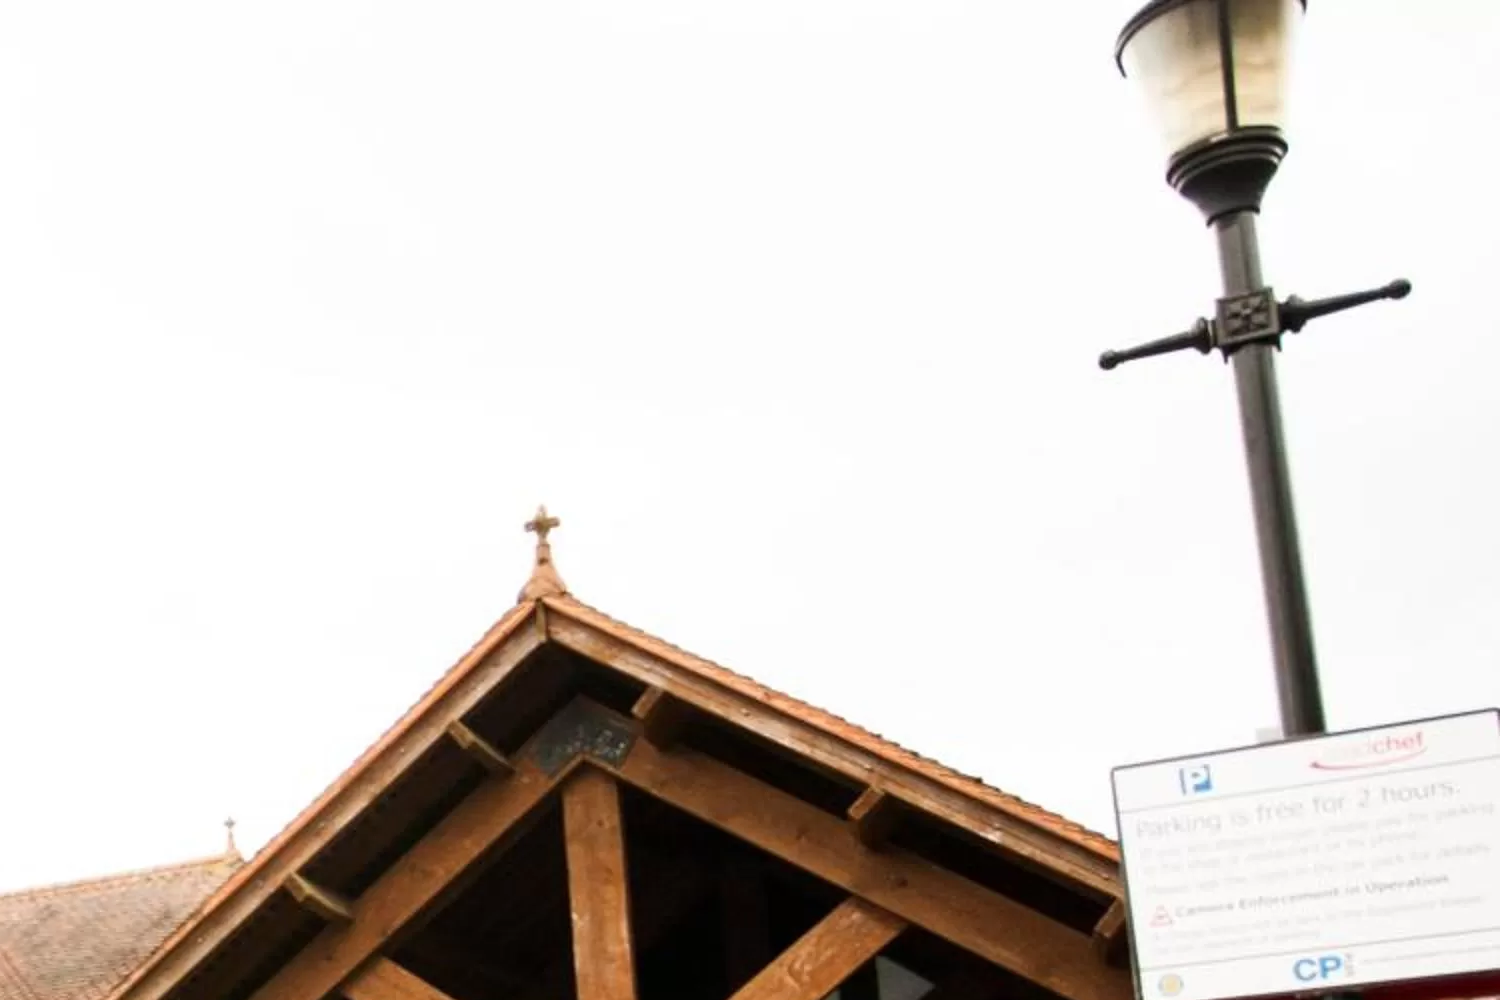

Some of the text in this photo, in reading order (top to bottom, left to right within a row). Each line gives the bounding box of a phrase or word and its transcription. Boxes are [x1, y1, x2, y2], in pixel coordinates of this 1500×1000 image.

[1135, 806, 1222, 841] Parking
[1230, 810, 1250, 827] is
[1254, 799, 1304, 823] free
[1312, 793, 1345, 816] for
[1356, 788, 1371, 809] 2
